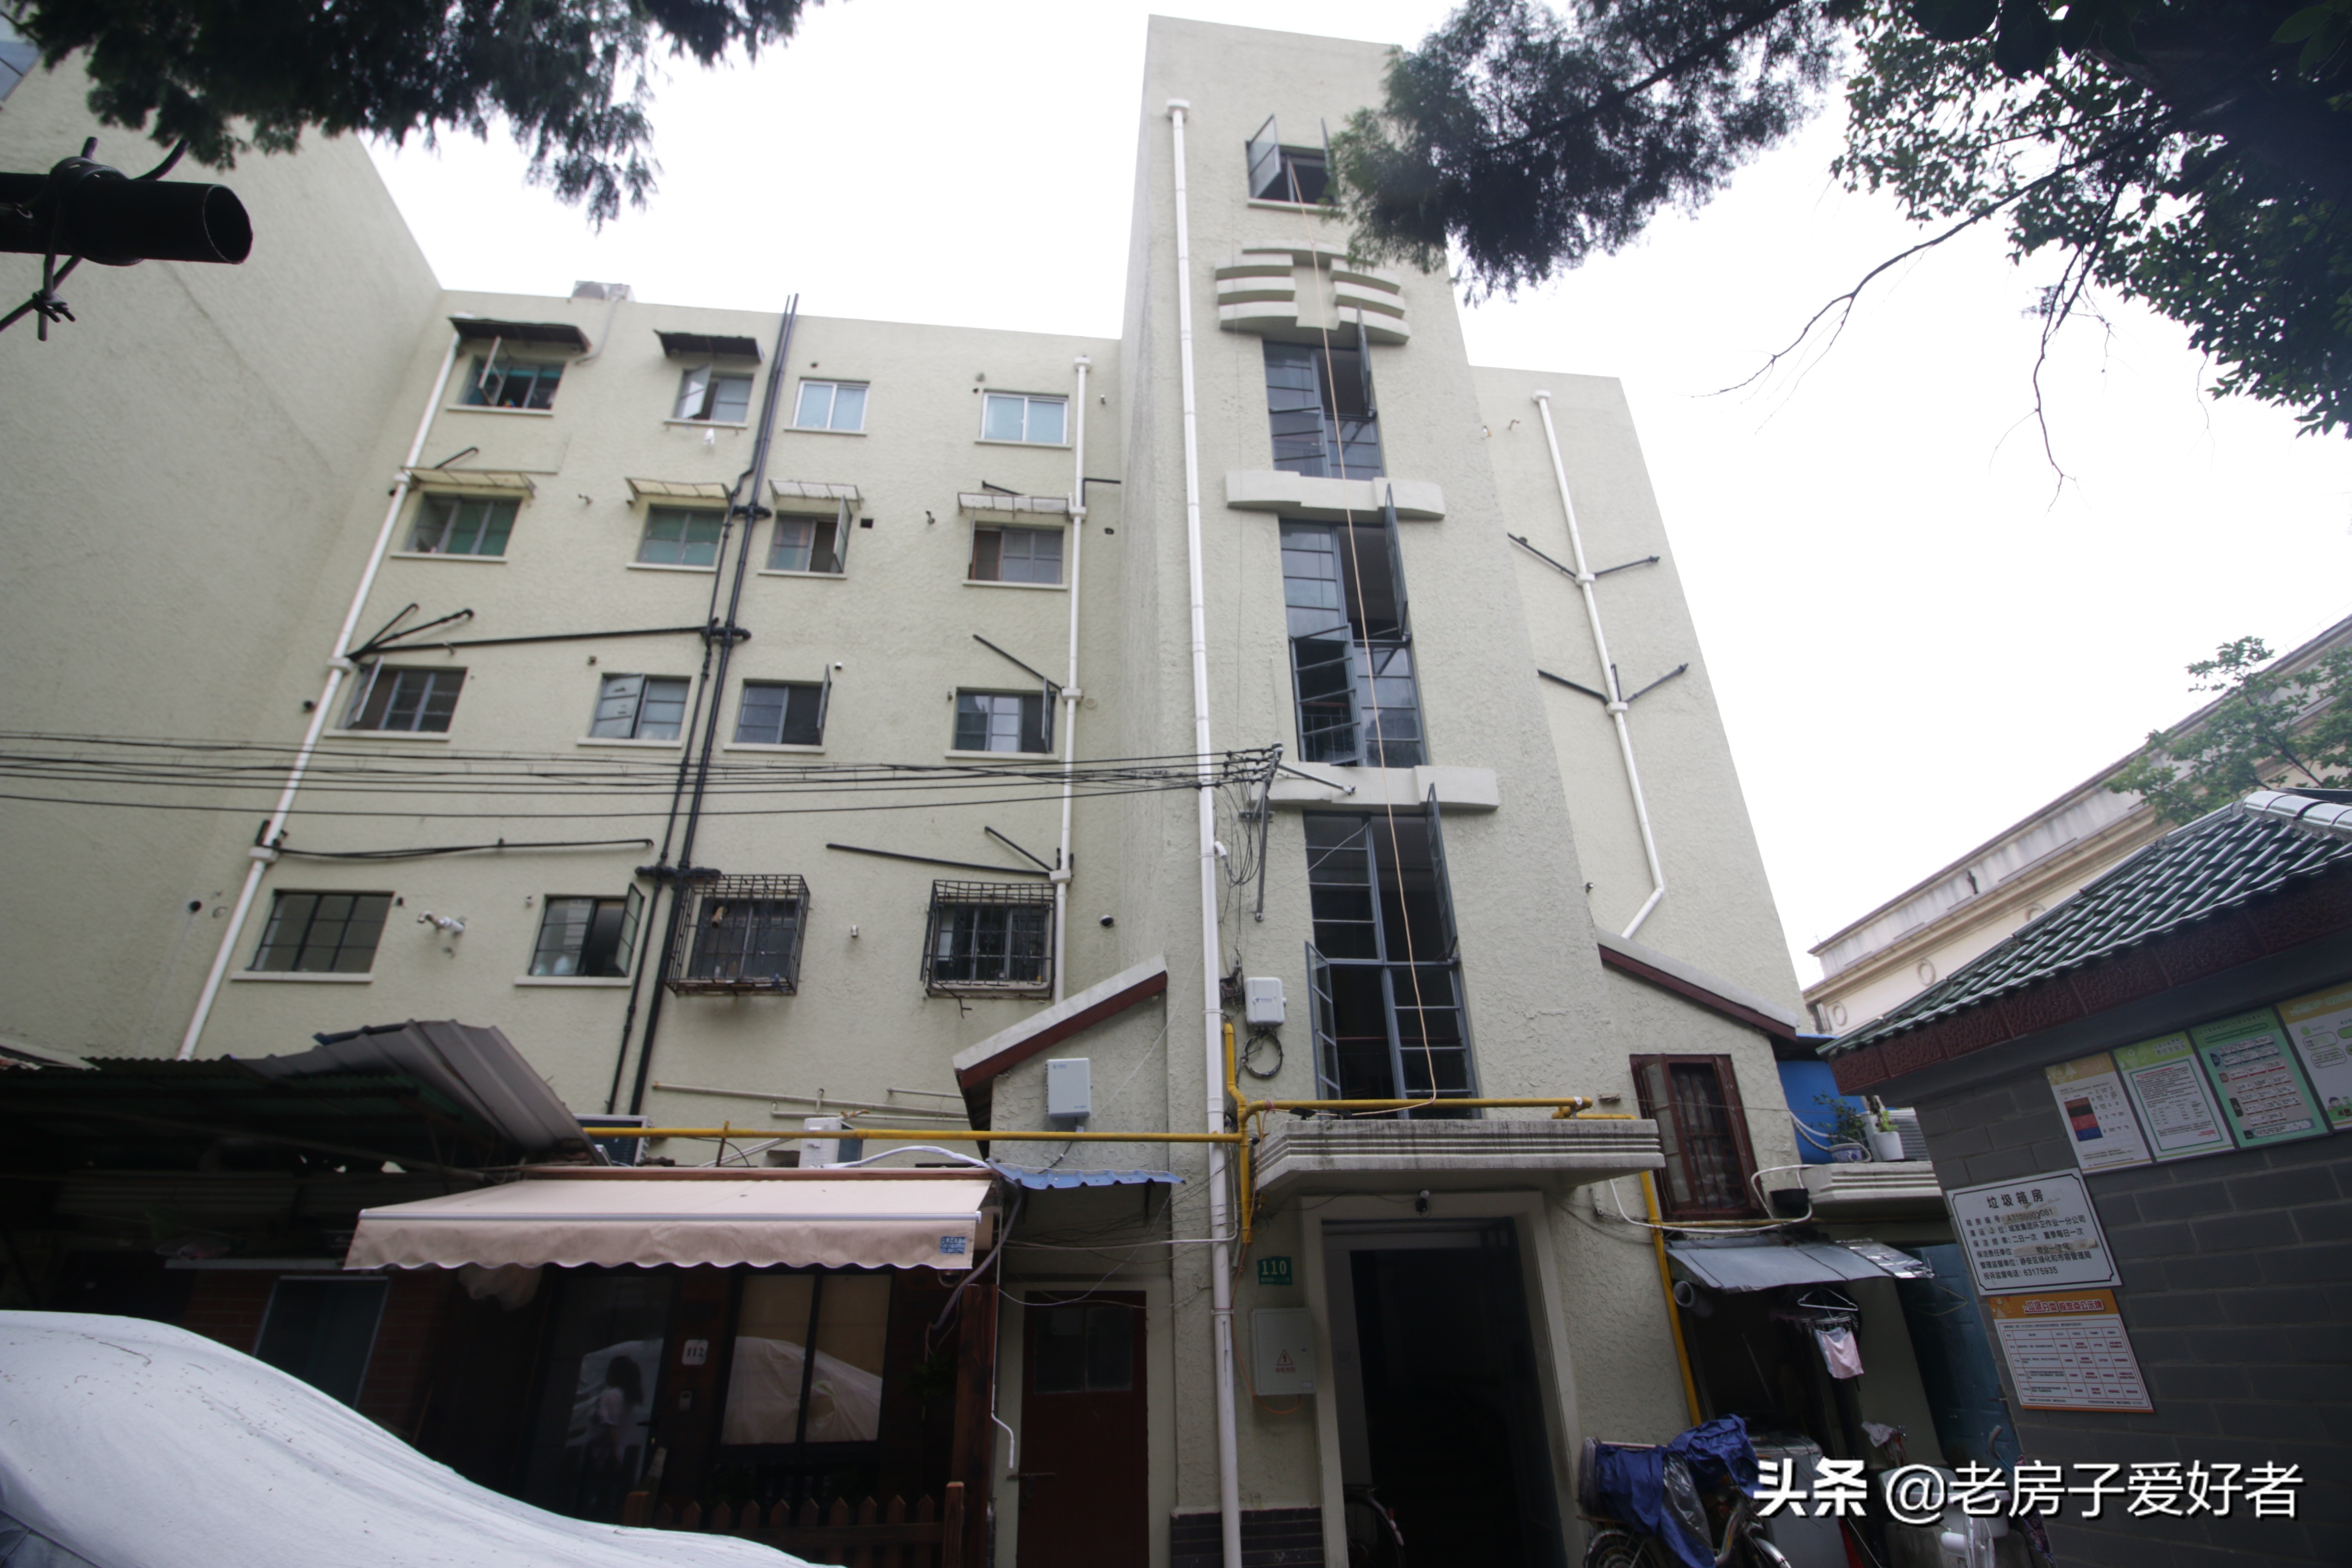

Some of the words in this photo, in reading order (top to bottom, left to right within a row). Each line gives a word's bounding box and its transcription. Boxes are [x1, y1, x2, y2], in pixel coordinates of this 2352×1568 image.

[1987, 1189, 2044, 1209] 垃圾箱房
[2043, 1227, 2085, 1240] 夏季每日一次
[1262, 1260, 1286, 1275] 110
[687, 1347, 704, 1357] 112
